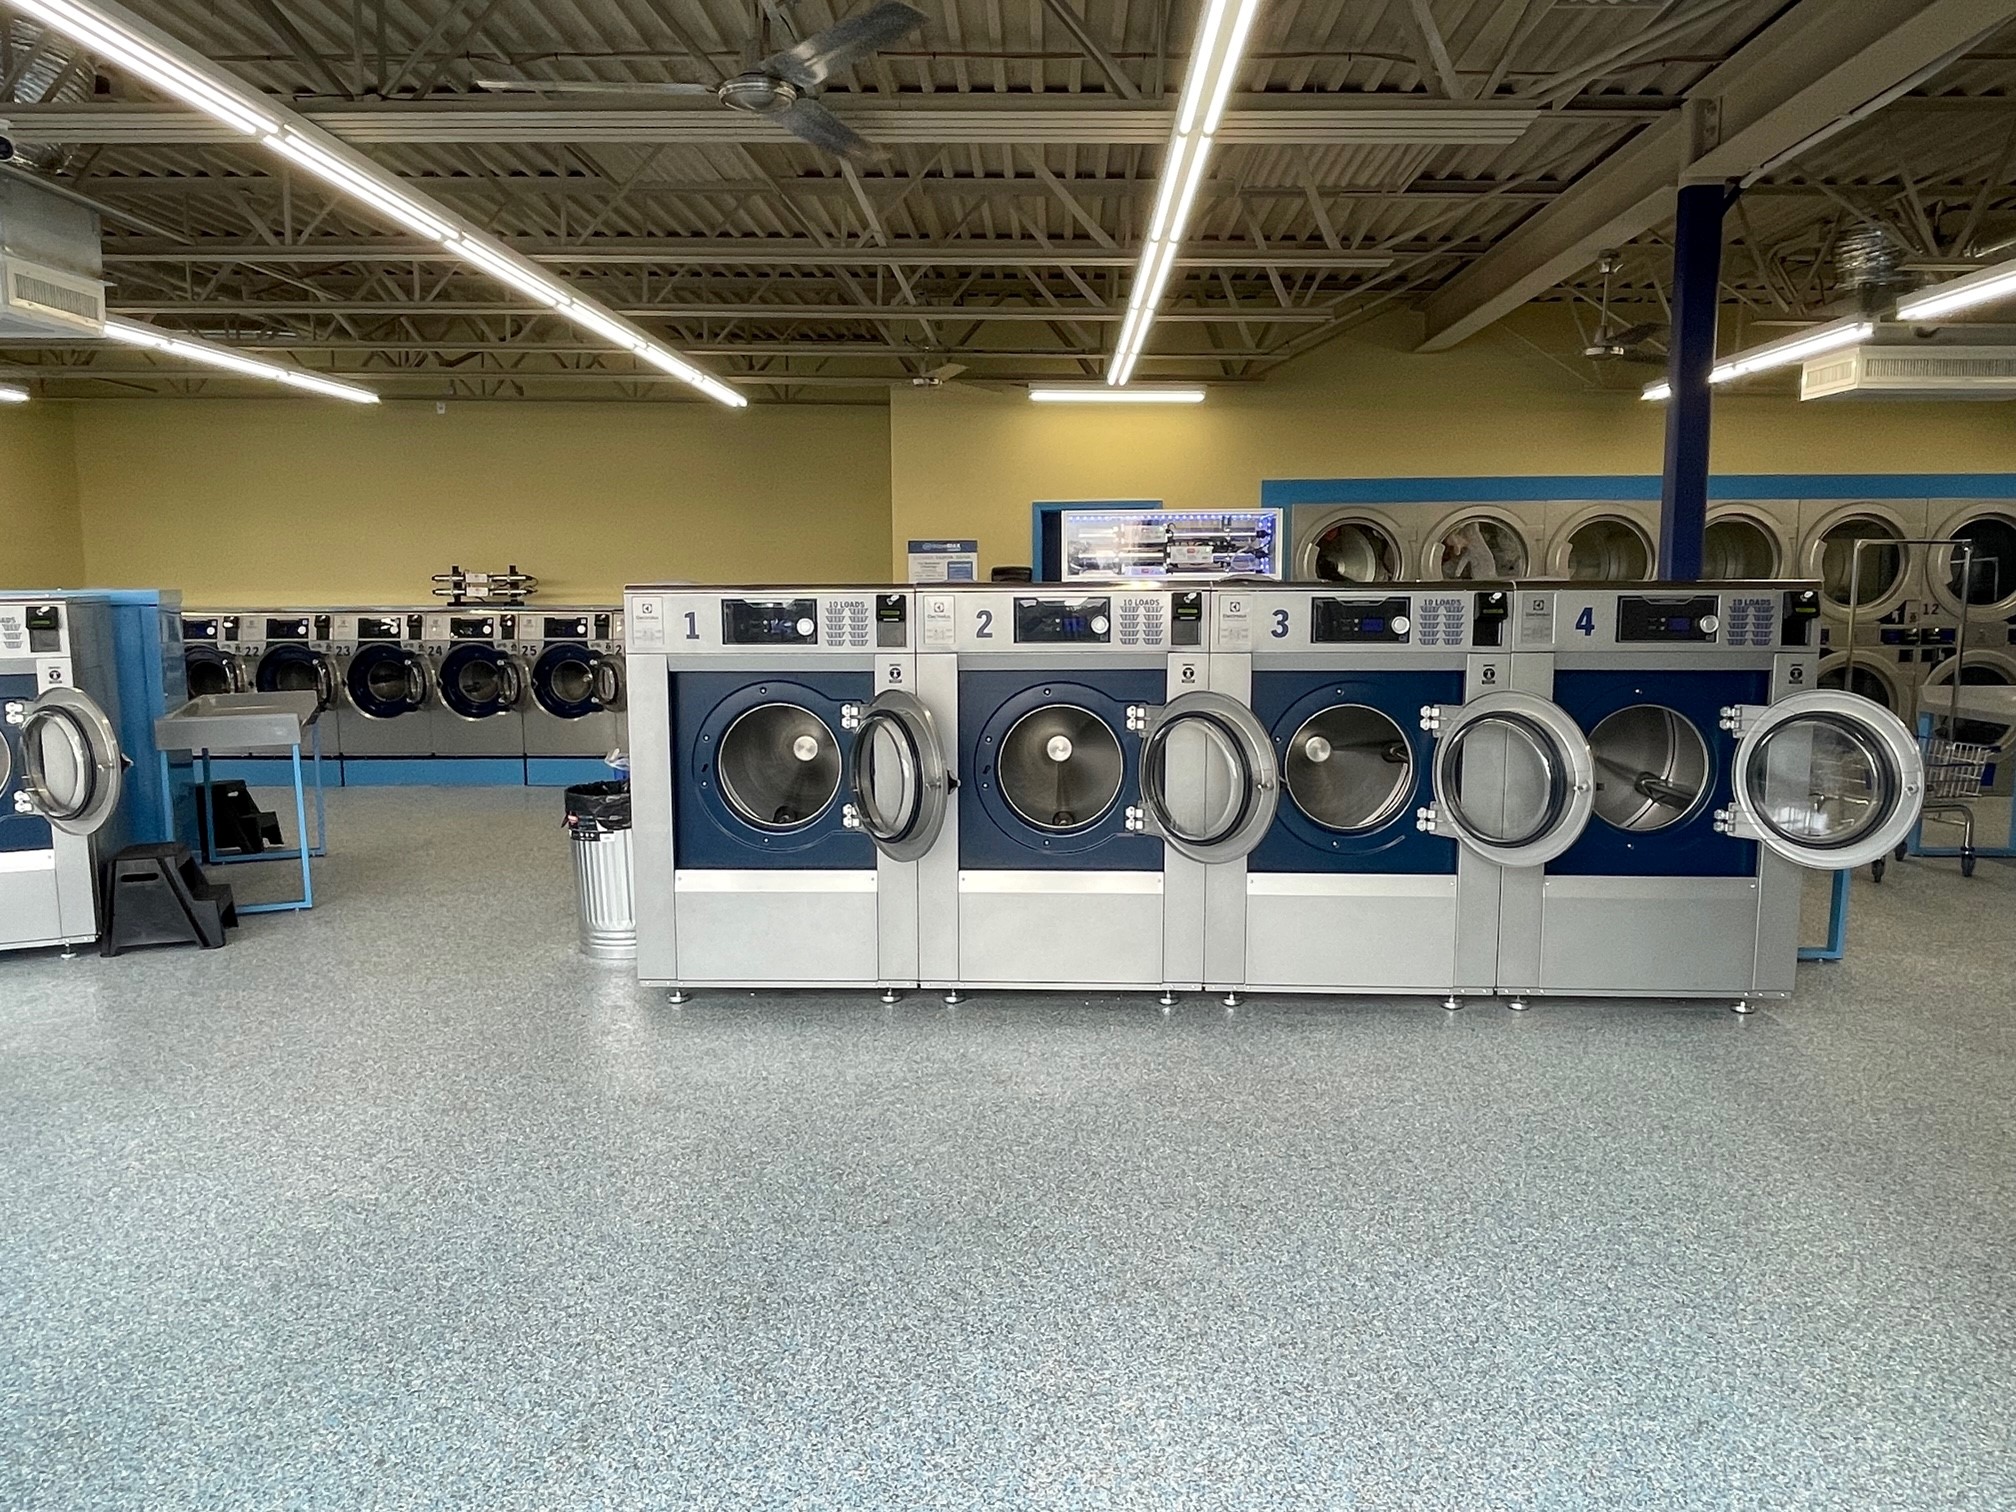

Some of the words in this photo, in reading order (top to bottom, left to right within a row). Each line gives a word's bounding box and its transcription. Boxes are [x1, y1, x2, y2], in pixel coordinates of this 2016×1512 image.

[1923, 603, 1939, 615] 12
[684, 612, 700, 639] 1
[976, 610, 993, 638] 2
[1271, 609, 1289, 638] 3
[1575, 607, 1595, 636] 4
[244, 646, 259, 657] 22
[336, 646, 351, 657] 23
[428, 645, 443, 657] 24
[522, 645, 537, 657] 25
